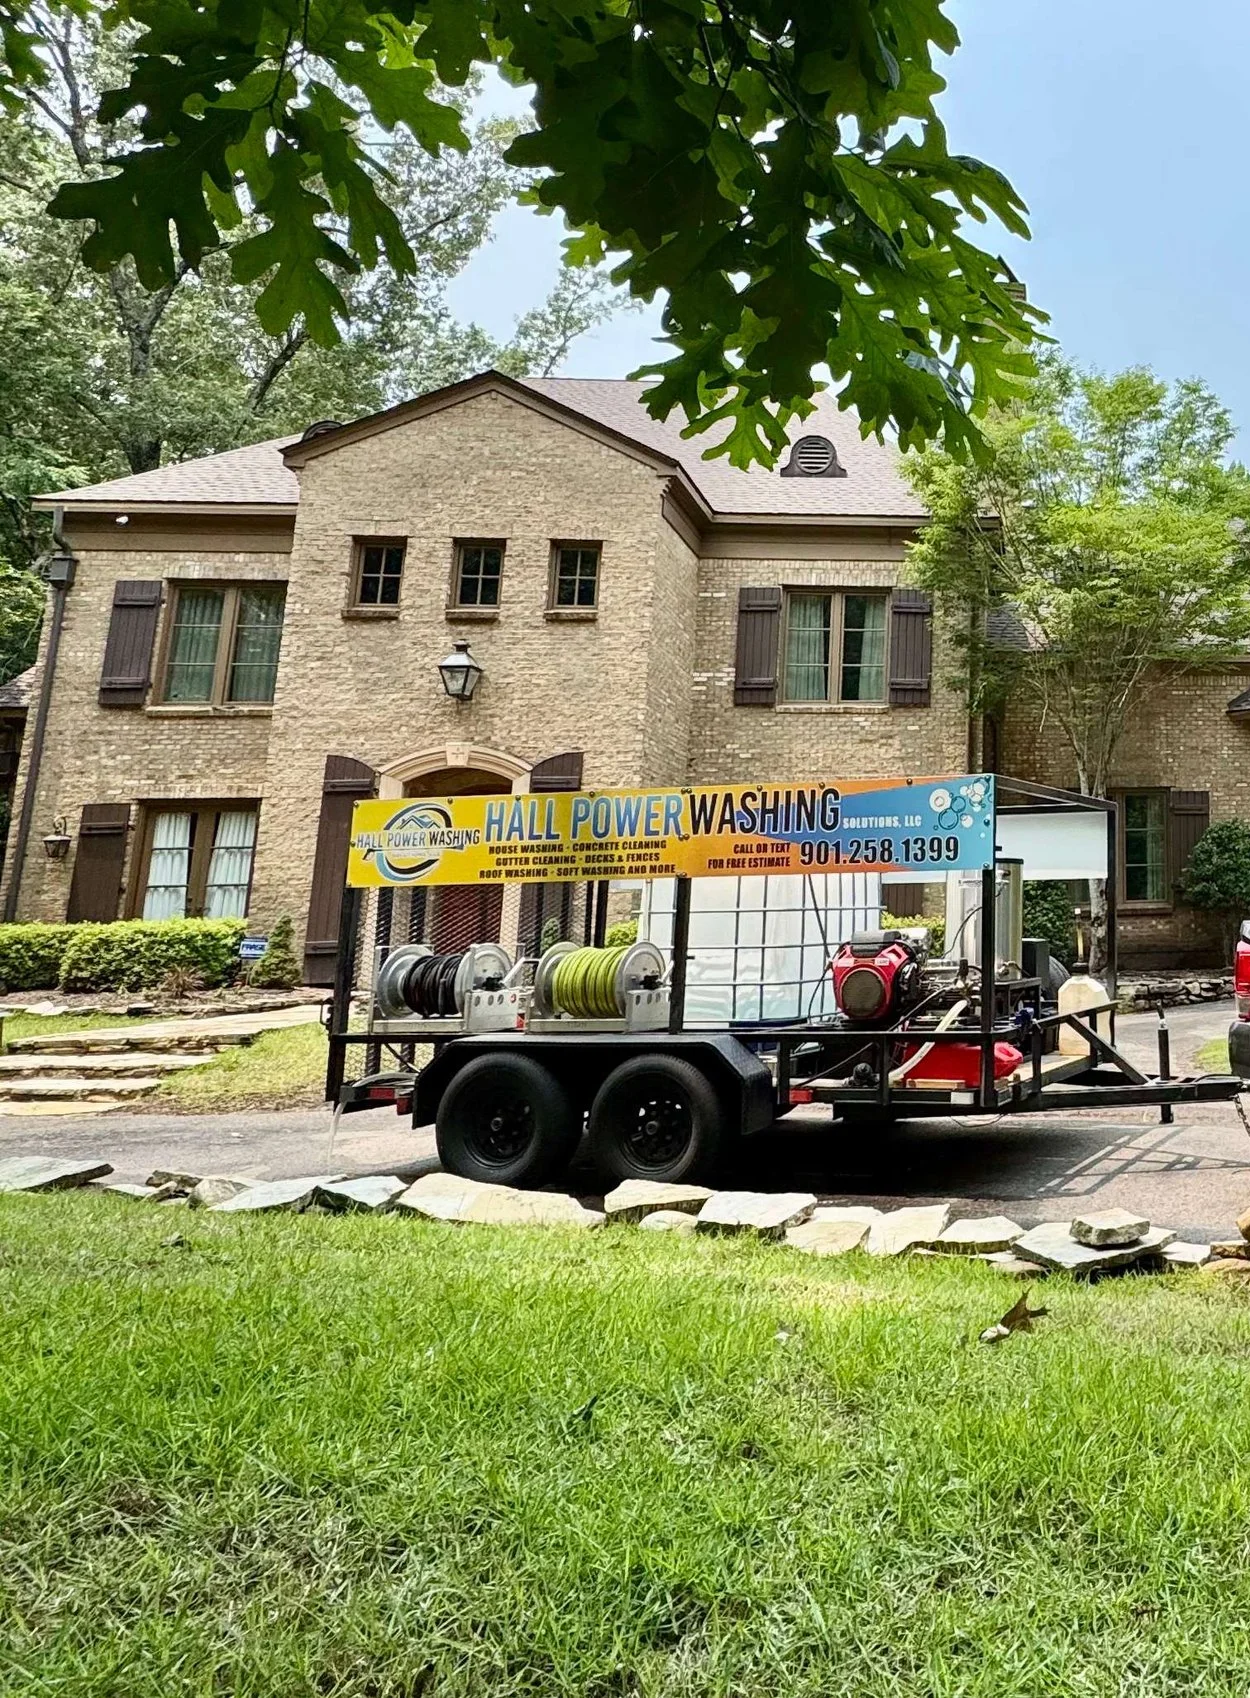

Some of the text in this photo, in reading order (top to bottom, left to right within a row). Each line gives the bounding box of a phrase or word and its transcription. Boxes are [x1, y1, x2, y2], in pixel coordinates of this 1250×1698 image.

[485, 788, 840, 843] HALL POWER WASHING
[843, 815, 922, 829] SOLUTIONS, LLC
[356, 829, 480, 849] HALL POWER WASHING
[488, 844, 519, 855] HOUSE
[521, 842, 564, 854] WASHING
[572, 841, 620, 852] CONCRETE
[622, 839, 667, 850] CLEANING
[733, 842, 790, 854] CALL OR TEXT
[800, 836, 959, 865] 901.258.1399
[495, 856, 530, 867] GUTTER
[532, 854, 576, 866] CLEANING
[585, 853, 615, 864] DECKS
[617, 853, 624, 863] &
[626, 852, 660, 862] FENCES
[708, 856, 790, 869] FOR FREE ESTIMATE
[479, 869, 503, 879] ROOF
[505, 867, 548, 878] WASHING
[556, 866, 580, 877] SOFT
[581, 865, 626, 876] WASHING
[627, 864, 647, 875] AND
[649, 863, 676, 874] MORE
